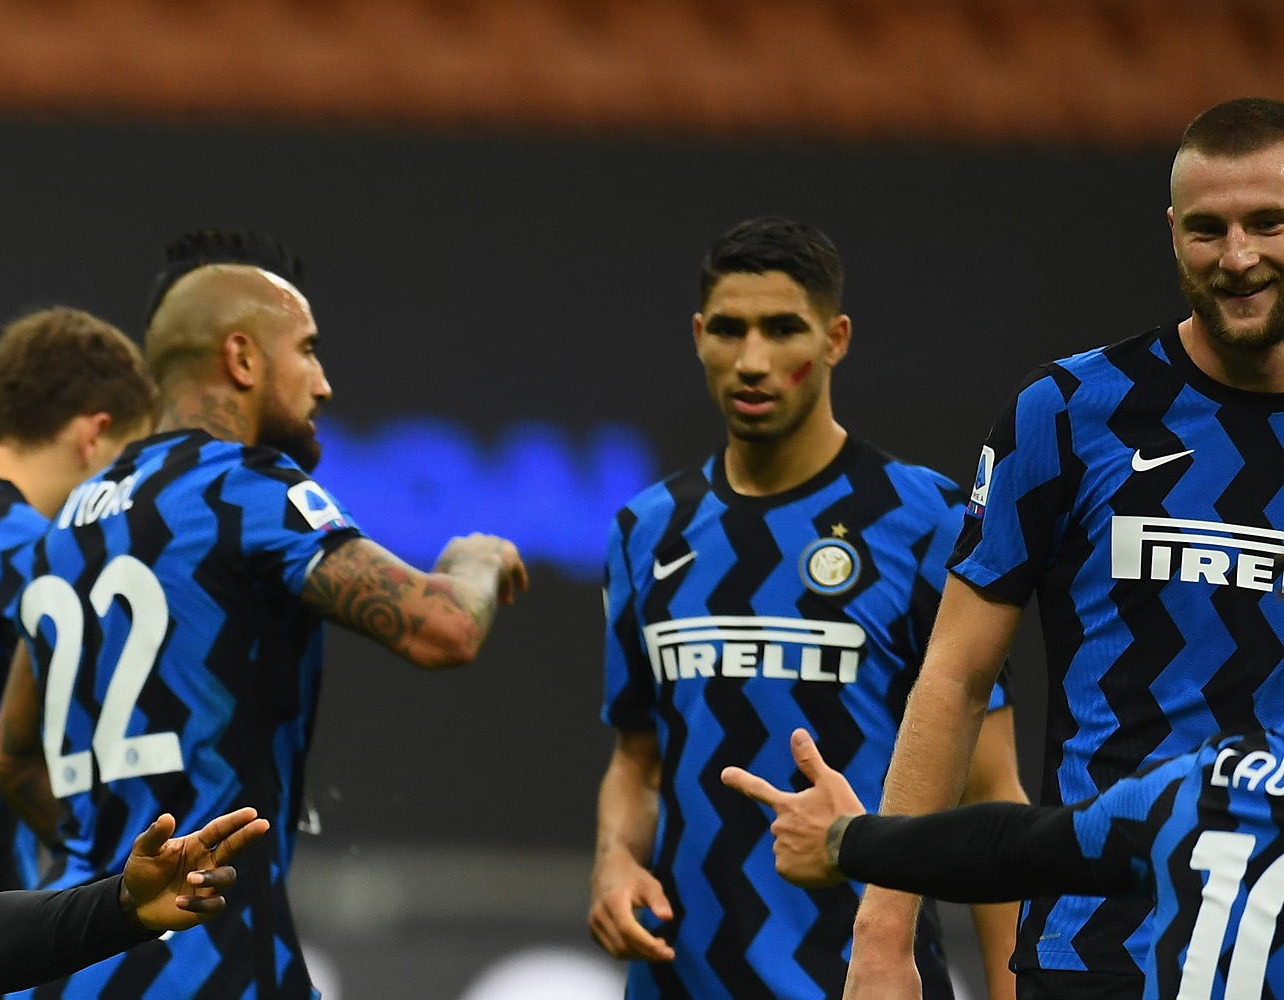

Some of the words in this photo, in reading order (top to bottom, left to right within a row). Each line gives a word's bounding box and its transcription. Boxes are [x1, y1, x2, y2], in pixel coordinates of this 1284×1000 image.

[313, 414, 656, 580] OAL
[1111, 515, 1284, 593] PIRE
[21, 555, 184, 798] 22
[642, 616, 866, 684] PIRELLI
